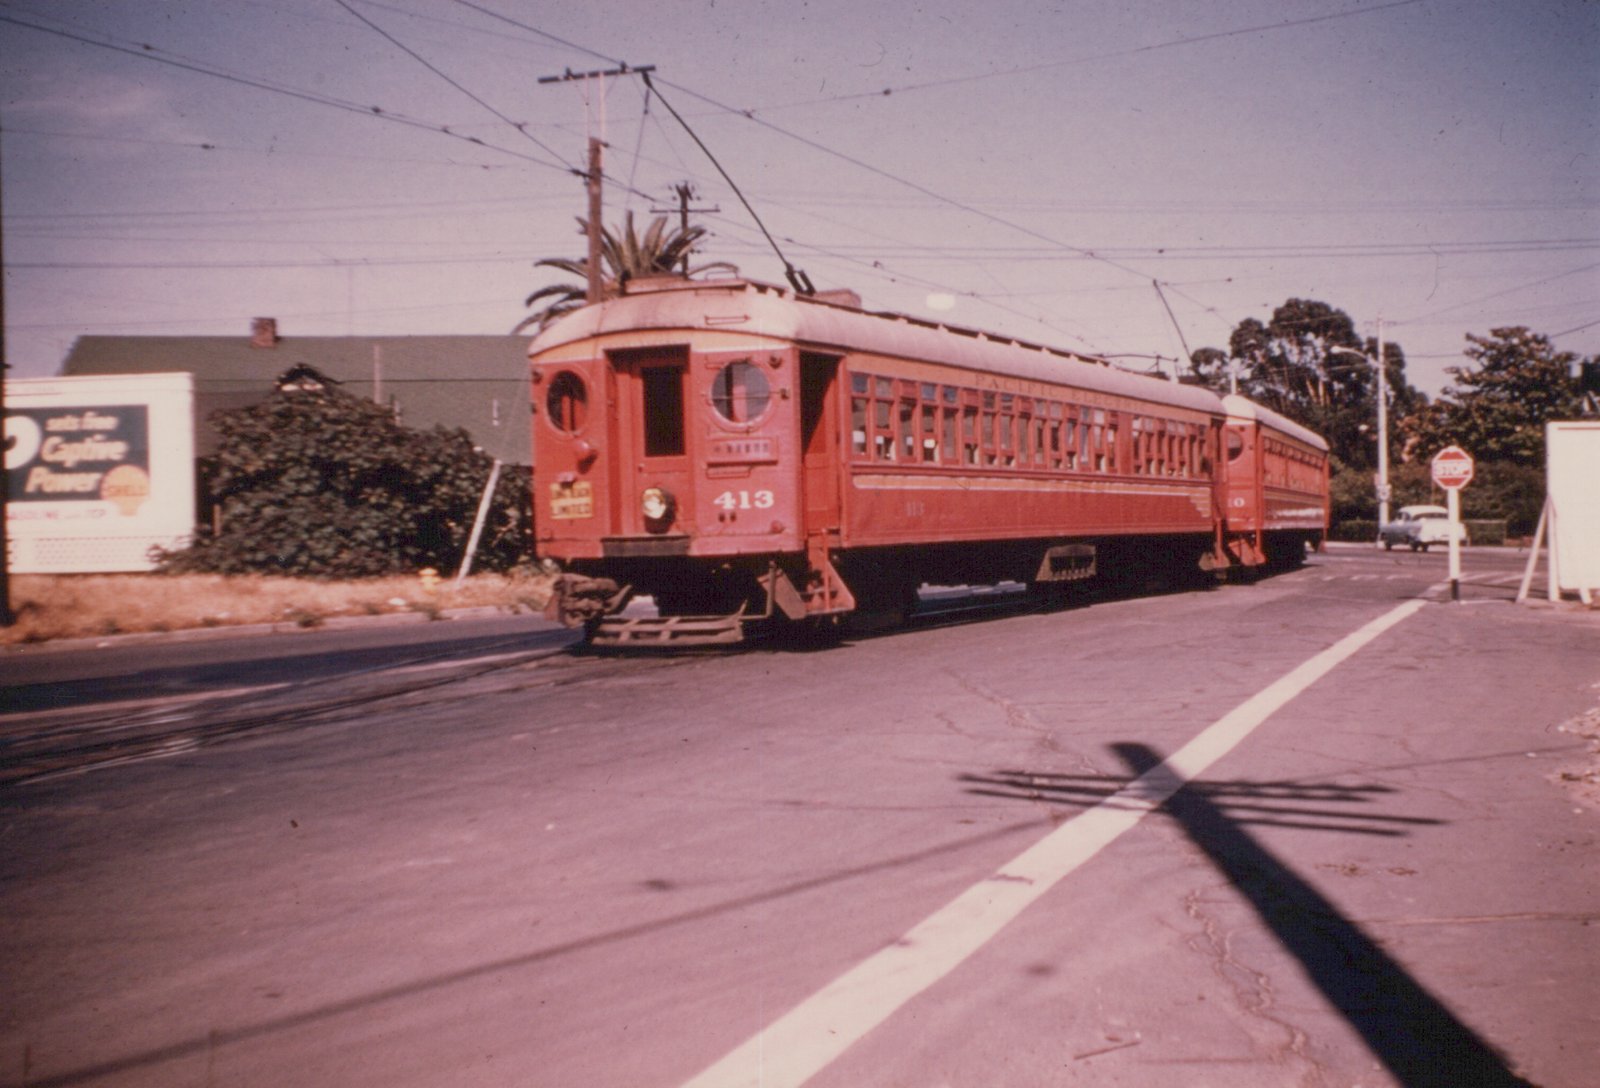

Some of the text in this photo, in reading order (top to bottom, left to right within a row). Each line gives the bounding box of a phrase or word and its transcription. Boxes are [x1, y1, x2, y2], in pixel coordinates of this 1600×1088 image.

[975, 374, 1056, 396] PACIFIC
[41, 434, 128, 468] Captive
[25, 466, 102, 493] Power
[1434, 461, 1470, 477] STOP
[713, 490, 774, 509] 413
